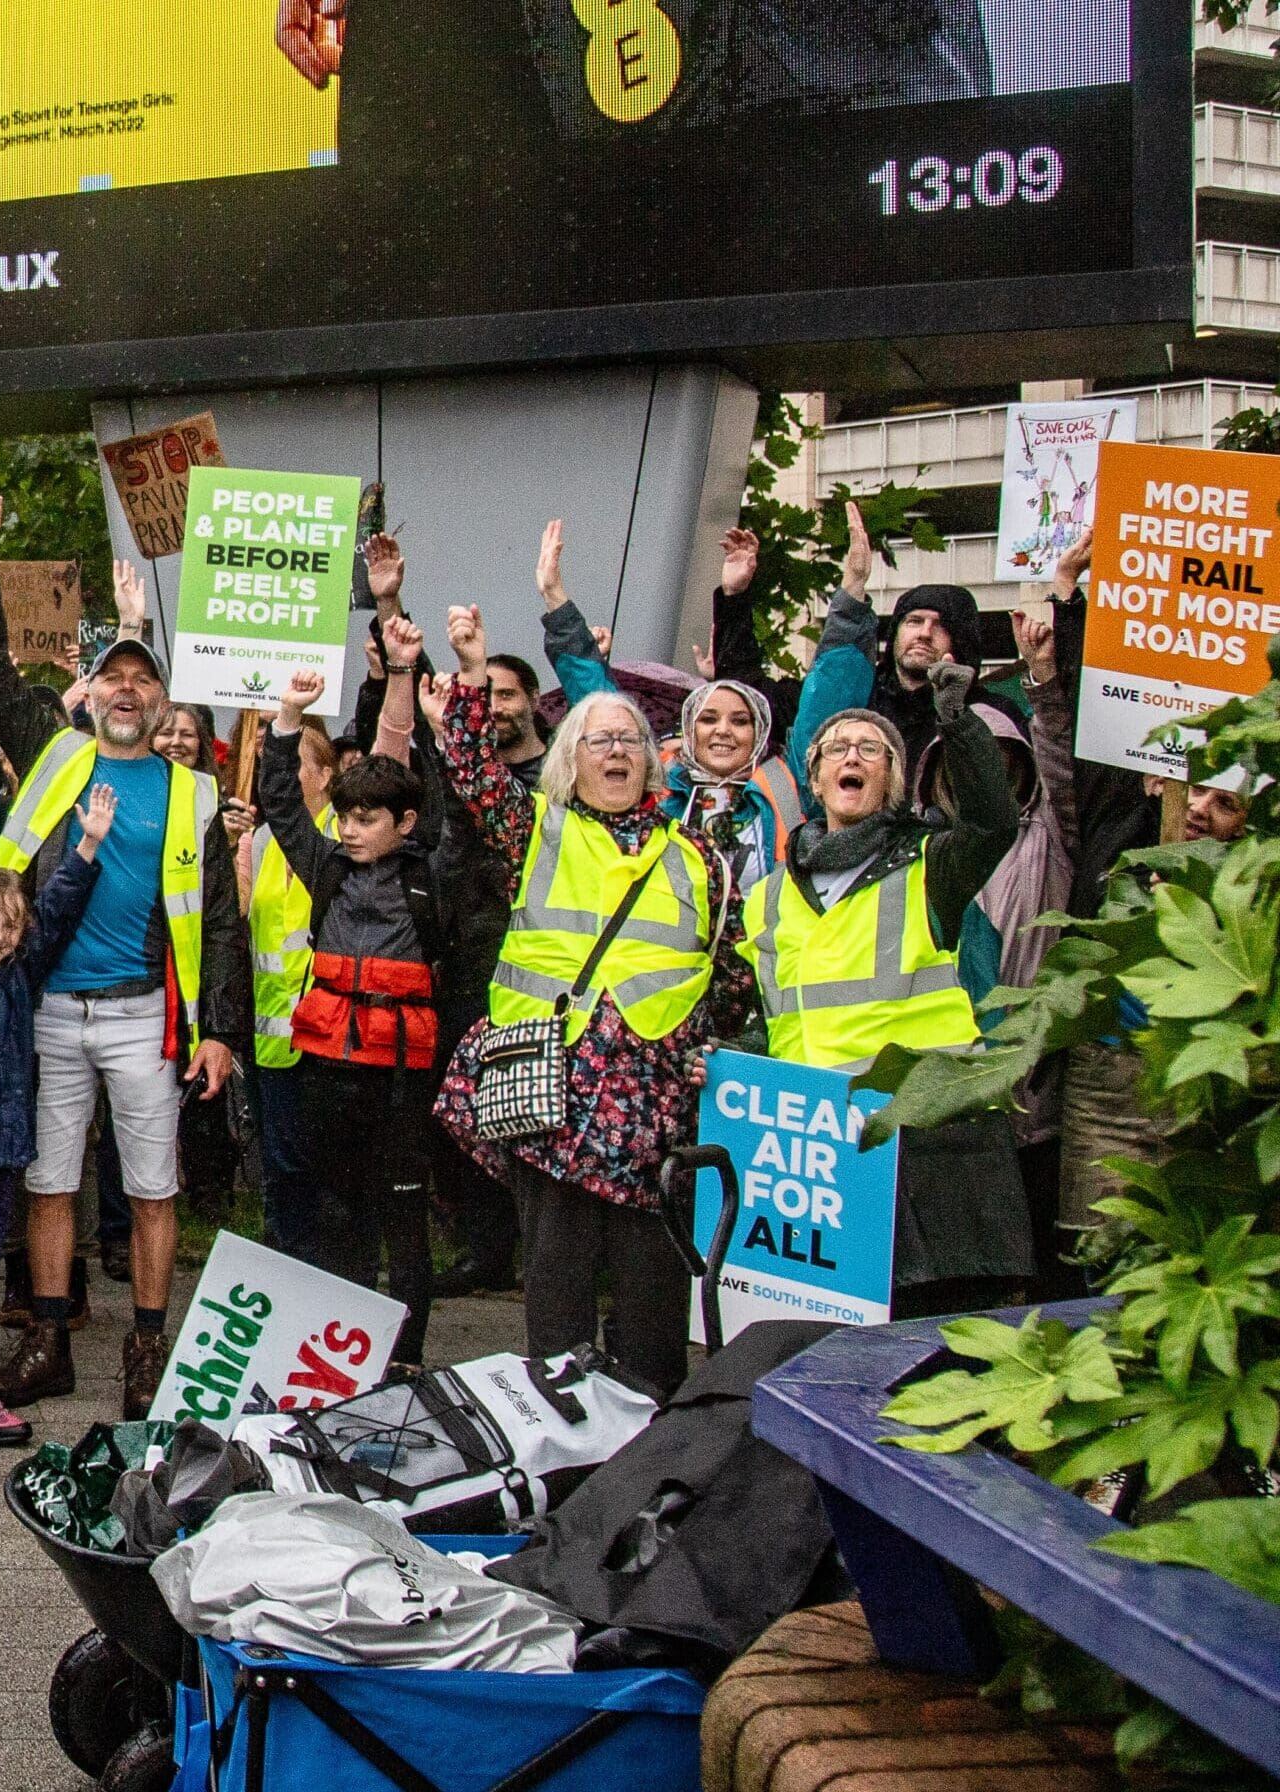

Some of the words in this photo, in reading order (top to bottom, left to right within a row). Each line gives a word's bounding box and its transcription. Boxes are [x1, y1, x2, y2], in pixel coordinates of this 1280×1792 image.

[12, 108, 51, 127] Sport
[54, 105, 73, 120] for
[78, 99, 139, 115] Teenage
[60, 122, 104, 139] March
[107, 115, 144, 134] 2022
[868, 147, 1064, 215] 13:09
[1036, 422, 1064, 435] SAVE
[1066, 418, 1095, 434] OUR
[119, 427, 201, 486] STOP
[126, 481, 188, 517] PAVIN
[213, 488, 334, 520] PEOPLE
[1144, 480, 1249, 519] MORE
[135, 511, 187, 551] PARA
[194, 514, 215, 538] &
[223, 517, 348, 548] PLANET
[1119, 513, 1272, 558] FREIGHT
[206, 543, 331, 573] BEFORE
[1120, 550, 1171, 582] ON
[1181, 557, 1264, 595] RAIL
[214, 571, 317, 600] PEEL'S
[207, 598, 320, 629] PROFIT
[1097, 580, 1169, 617] NOT
[1177, 592, 1280, 634] MORE
[194, 644, 226, 656] SAVE
[229, 647, 271, 660] SOUTH
[275, 651, 324, 664] SEFTON
[1124, 620, 1246, 666] ROADS
[214, 690, 232, 698] SAVE
[234, 692, 266, 701] RIMROSE
[268, 694, 283, 702] VAL
[1102, 684, 1140, 703] SAVE
[1143, 692, 1193, 713] SOUTH
[1125, 749, 1148, 760] SAVE
[1149, 754, 1189, 769] RIMROSE
[751, 1131, 837, 1184] AIR
[743, 1169, 843, 1229] FOR
[743, 1215, 837, 1270] ALL
[753, 1284, 802, 1307] SOUTH
[806, 1299, 864, 1325] SEFTON
